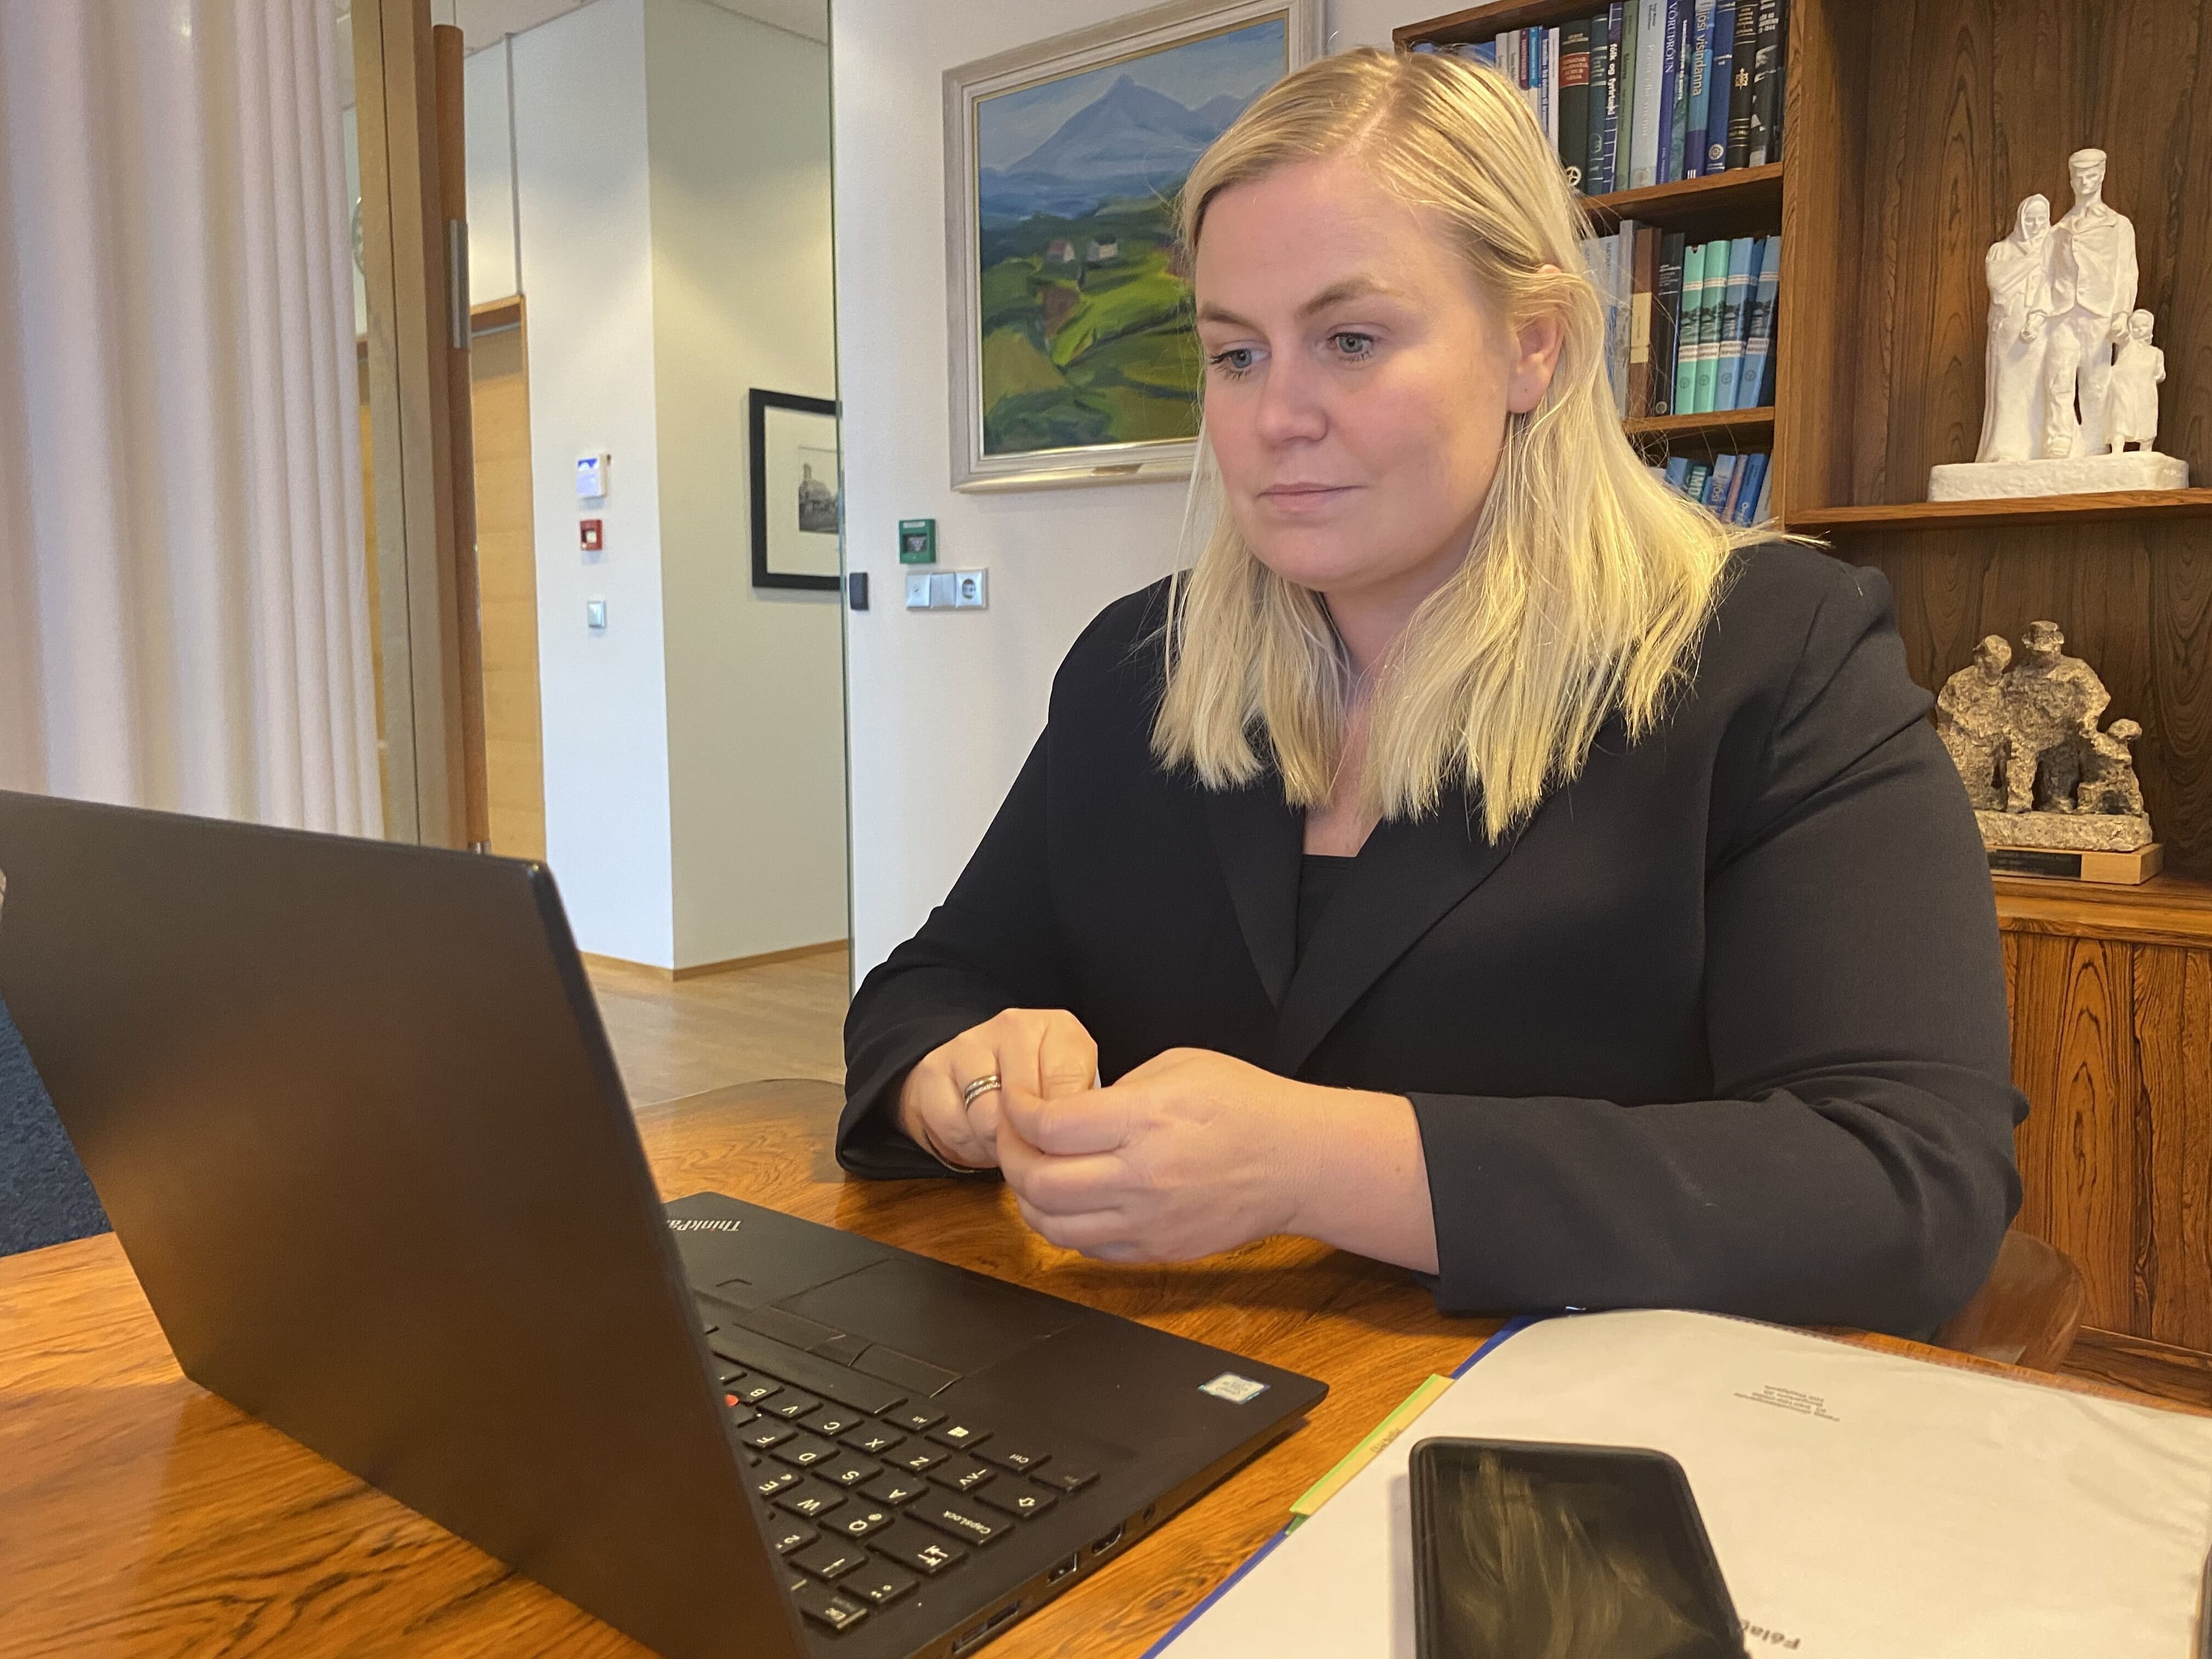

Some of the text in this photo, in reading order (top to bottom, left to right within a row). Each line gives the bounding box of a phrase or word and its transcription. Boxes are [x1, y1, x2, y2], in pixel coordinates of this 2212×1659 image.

[1665, 2, 1678, 73] VÖRUÞRÓUN
[1607, 43, 1618, 116] fólk og fyrirtæki
[750, 1388, 767, 1397] B
[782, 1406, 798, 1414] V
[823, 1422, 840, 1430] C
[865, 1438, 884, 1448] X
[798, 1453, 817, 1461] D
[910, 1456, 929, 1467] Z
[1009, 1454, 1029, 1463] Ctrl
[842, 1471, 859, 1480] S
[759, 1480, 779, 1491] E
[889, 1489, 907, 1499] A
[797, 1499, 821, 1511] W
[849, 1520, 868, 1531] Q
[943, 1510, 991, 1534] CapsLock
[784, 1535, 800, 1544] 2
